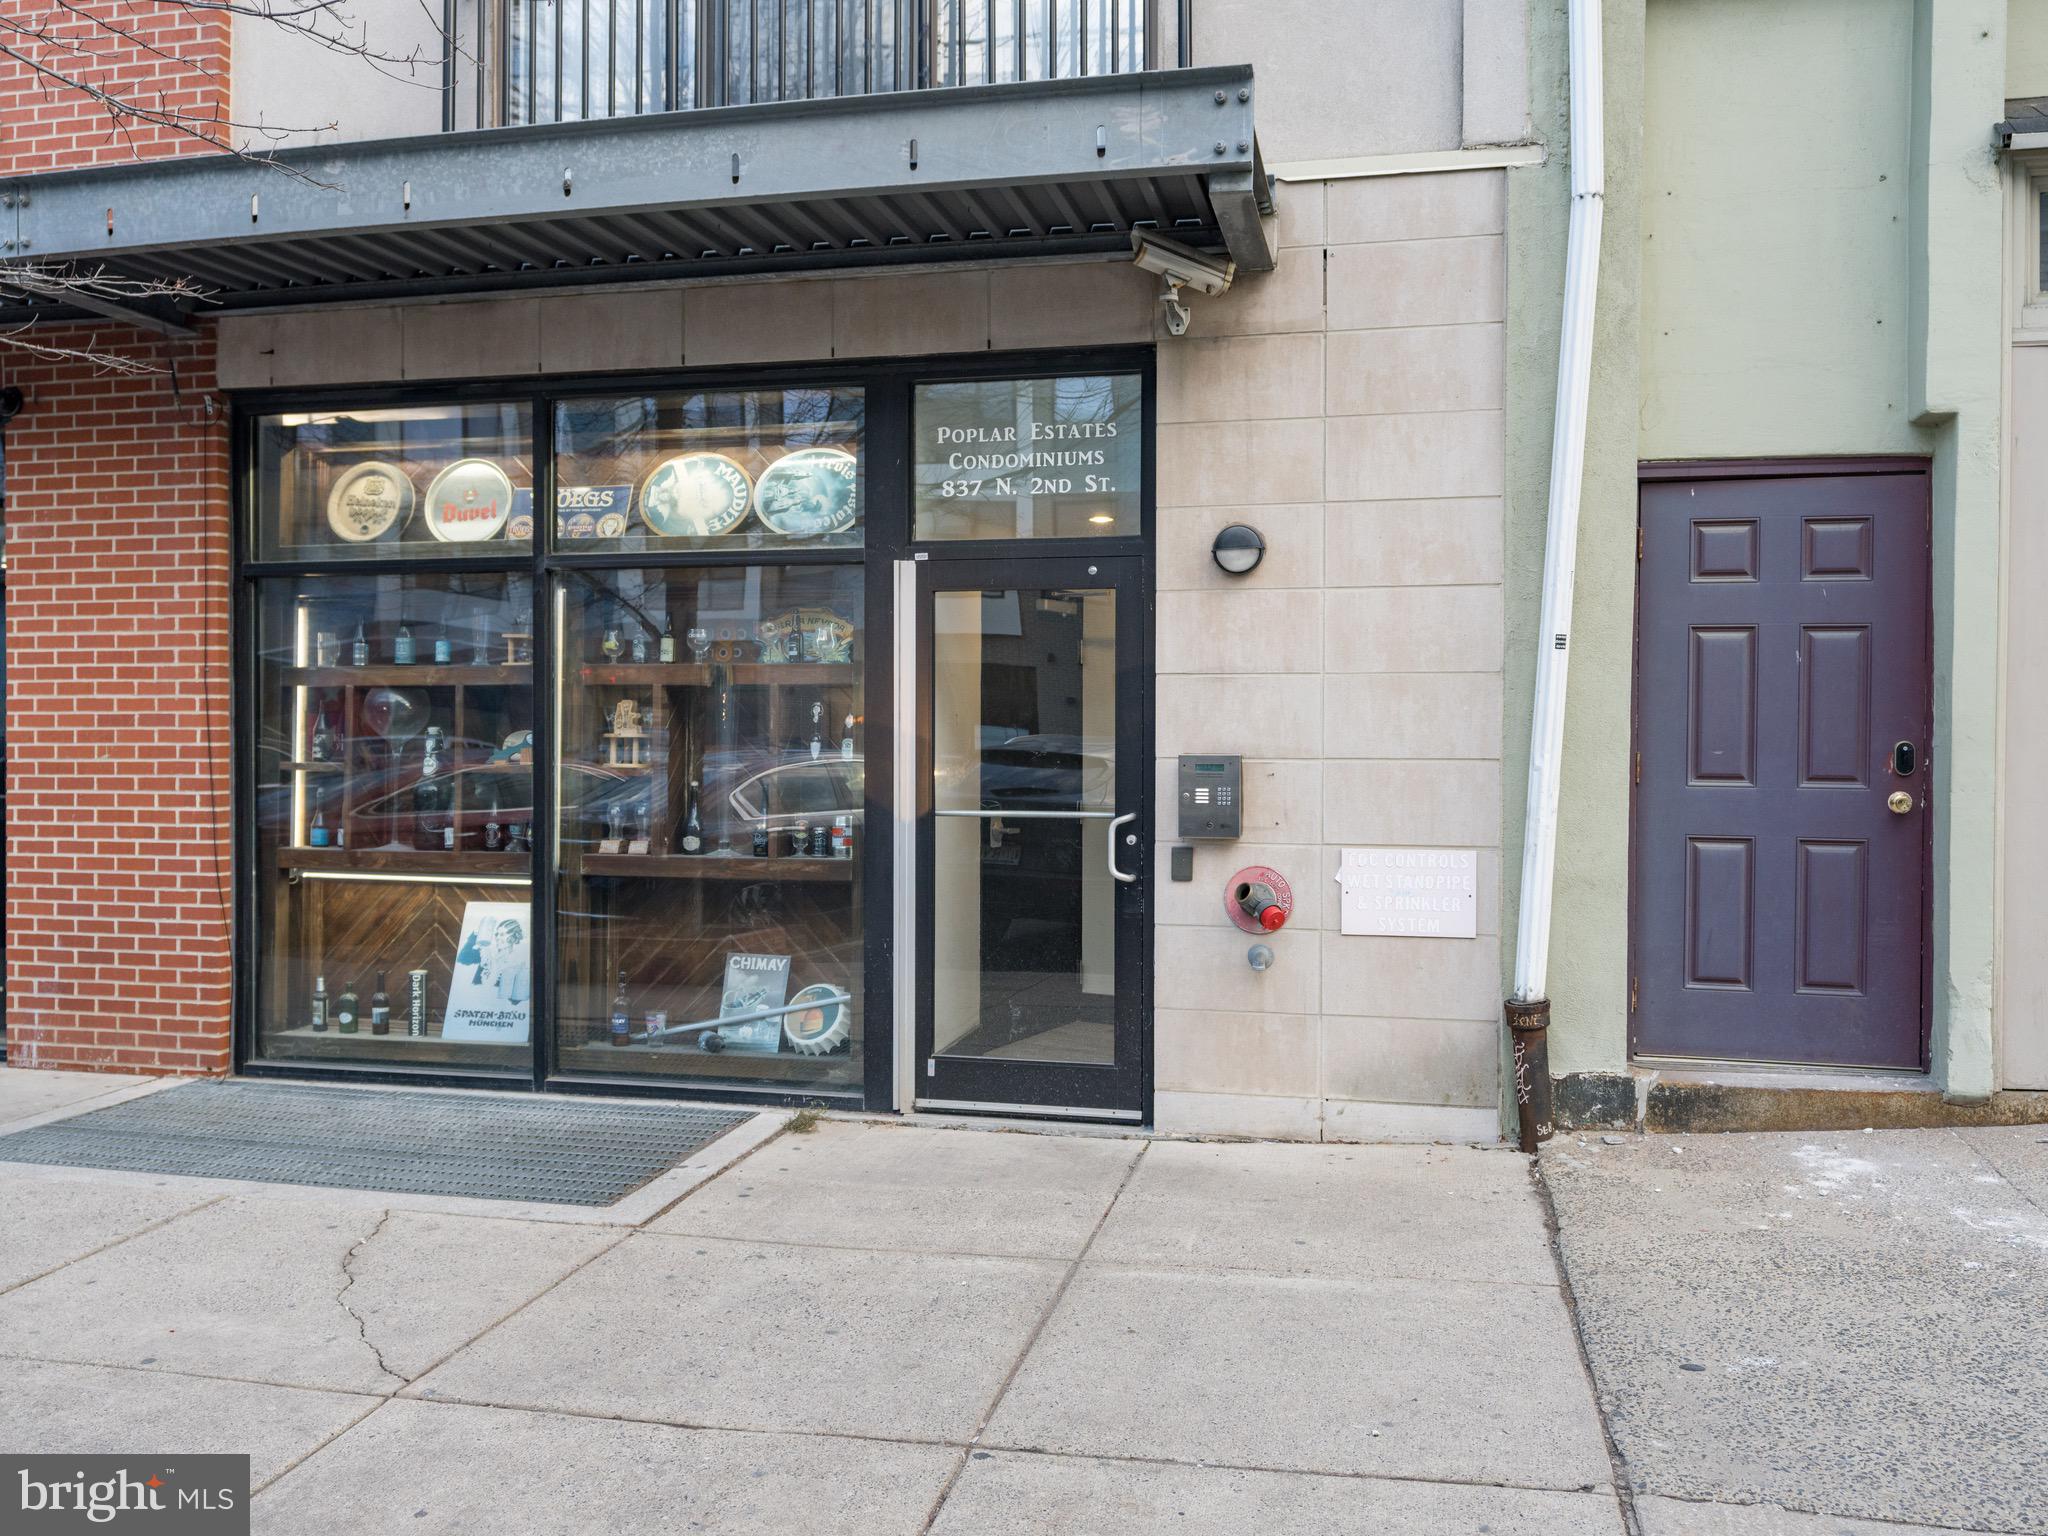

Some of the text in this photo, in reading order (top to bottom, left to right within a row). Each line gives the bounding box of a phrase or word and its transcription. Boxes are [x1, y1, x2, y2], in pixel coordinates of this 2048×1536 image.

[936, 422, 1118, 444] POPLAR ESTATES
[949, 450, 1105, 470] CONDOMINIUMS
[941, 474, 1116, 498] 837 N. 2ND ST.
[714, 461, 748, 533] MAUDITE
[442, 500, 498, 524] Duvel
[1384, 853, 1470, 869] CONTROLS
[1348, 874, 1472, 891] WET STANDPIPE
[1375, 896, 1461, 912] SPRINKLER
[1378, 917, 1441, 933] SYSTEM
[729, 956, 788, 971] CHIMAY
[411, 975, 422, 1037] Dark Horizon
[468, 1018, 514, 1028] MÜNCHEN
